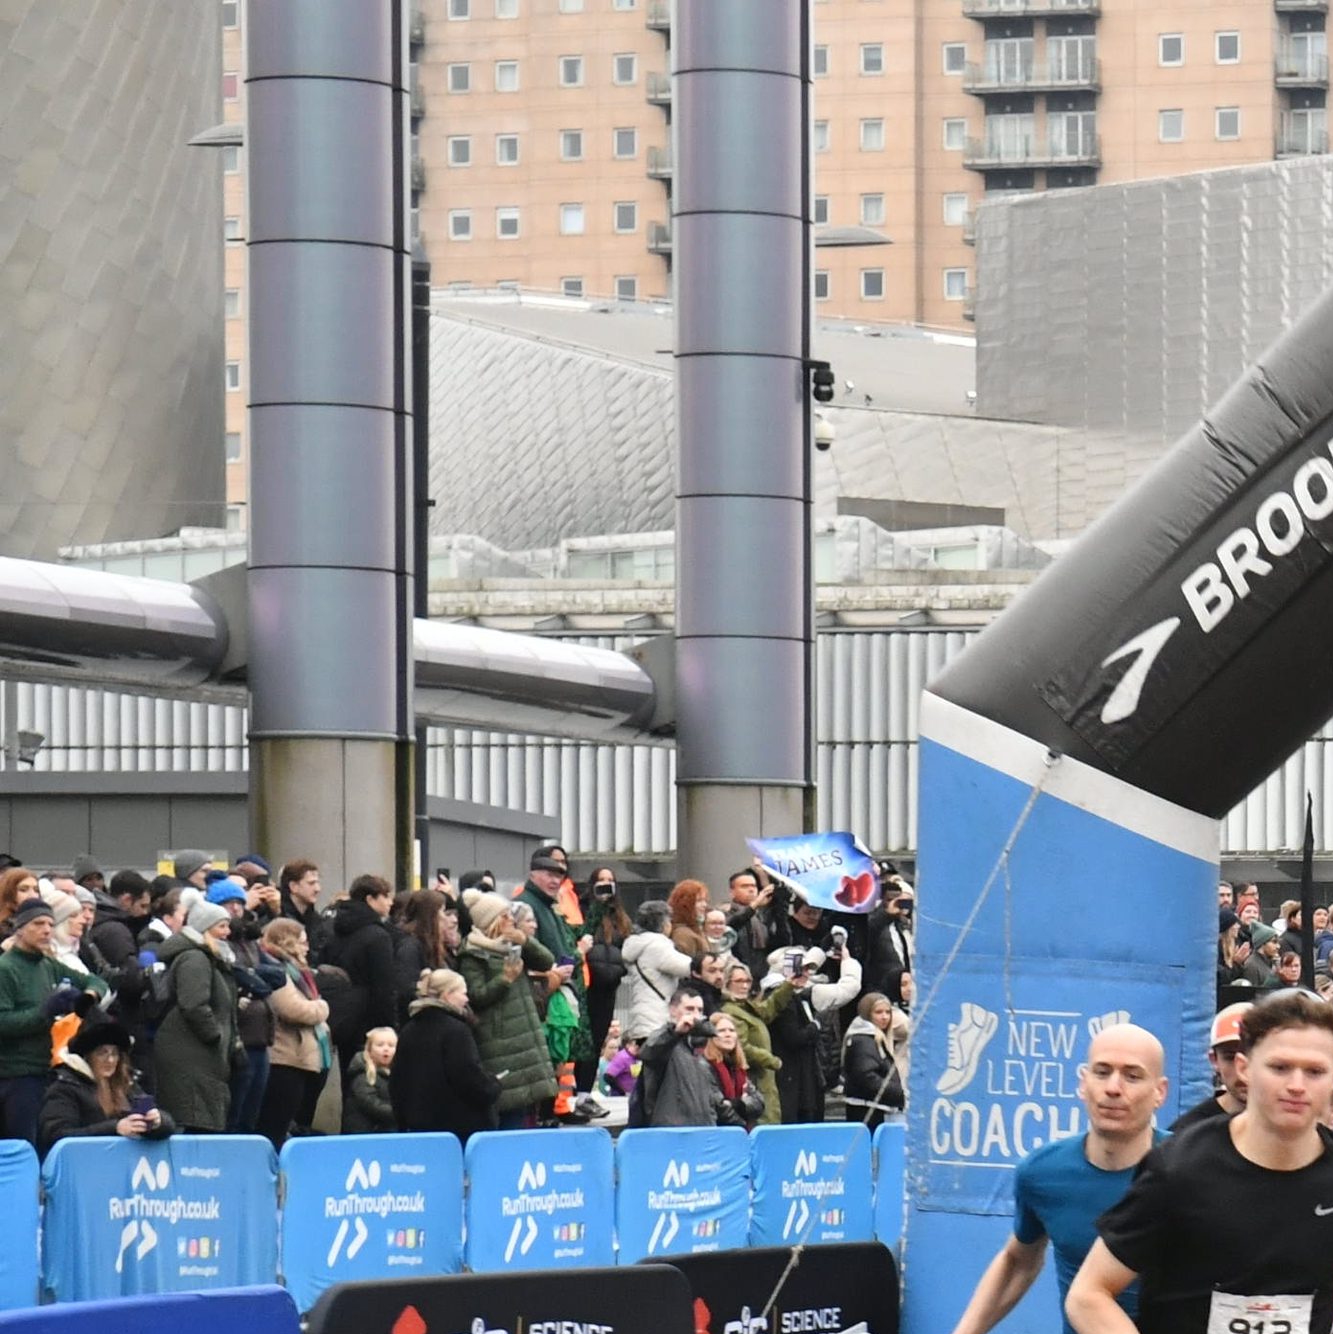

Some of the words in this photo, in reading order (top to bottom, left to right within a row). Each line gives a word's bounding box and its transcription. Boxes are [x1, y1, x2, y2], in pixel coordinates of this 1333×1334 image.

[774, 849, 843, 877] JAMES
[1007, 1021, 1078, 1059] NEW
[930, 1097, 1082, 1157] COACH
[324, 1190, 425, 1218] RunThrough.co.uk
[502, 1188, 584, 1217] RunThrough.co.uk
[781, 1308, 841, 1334] SCIENCE
